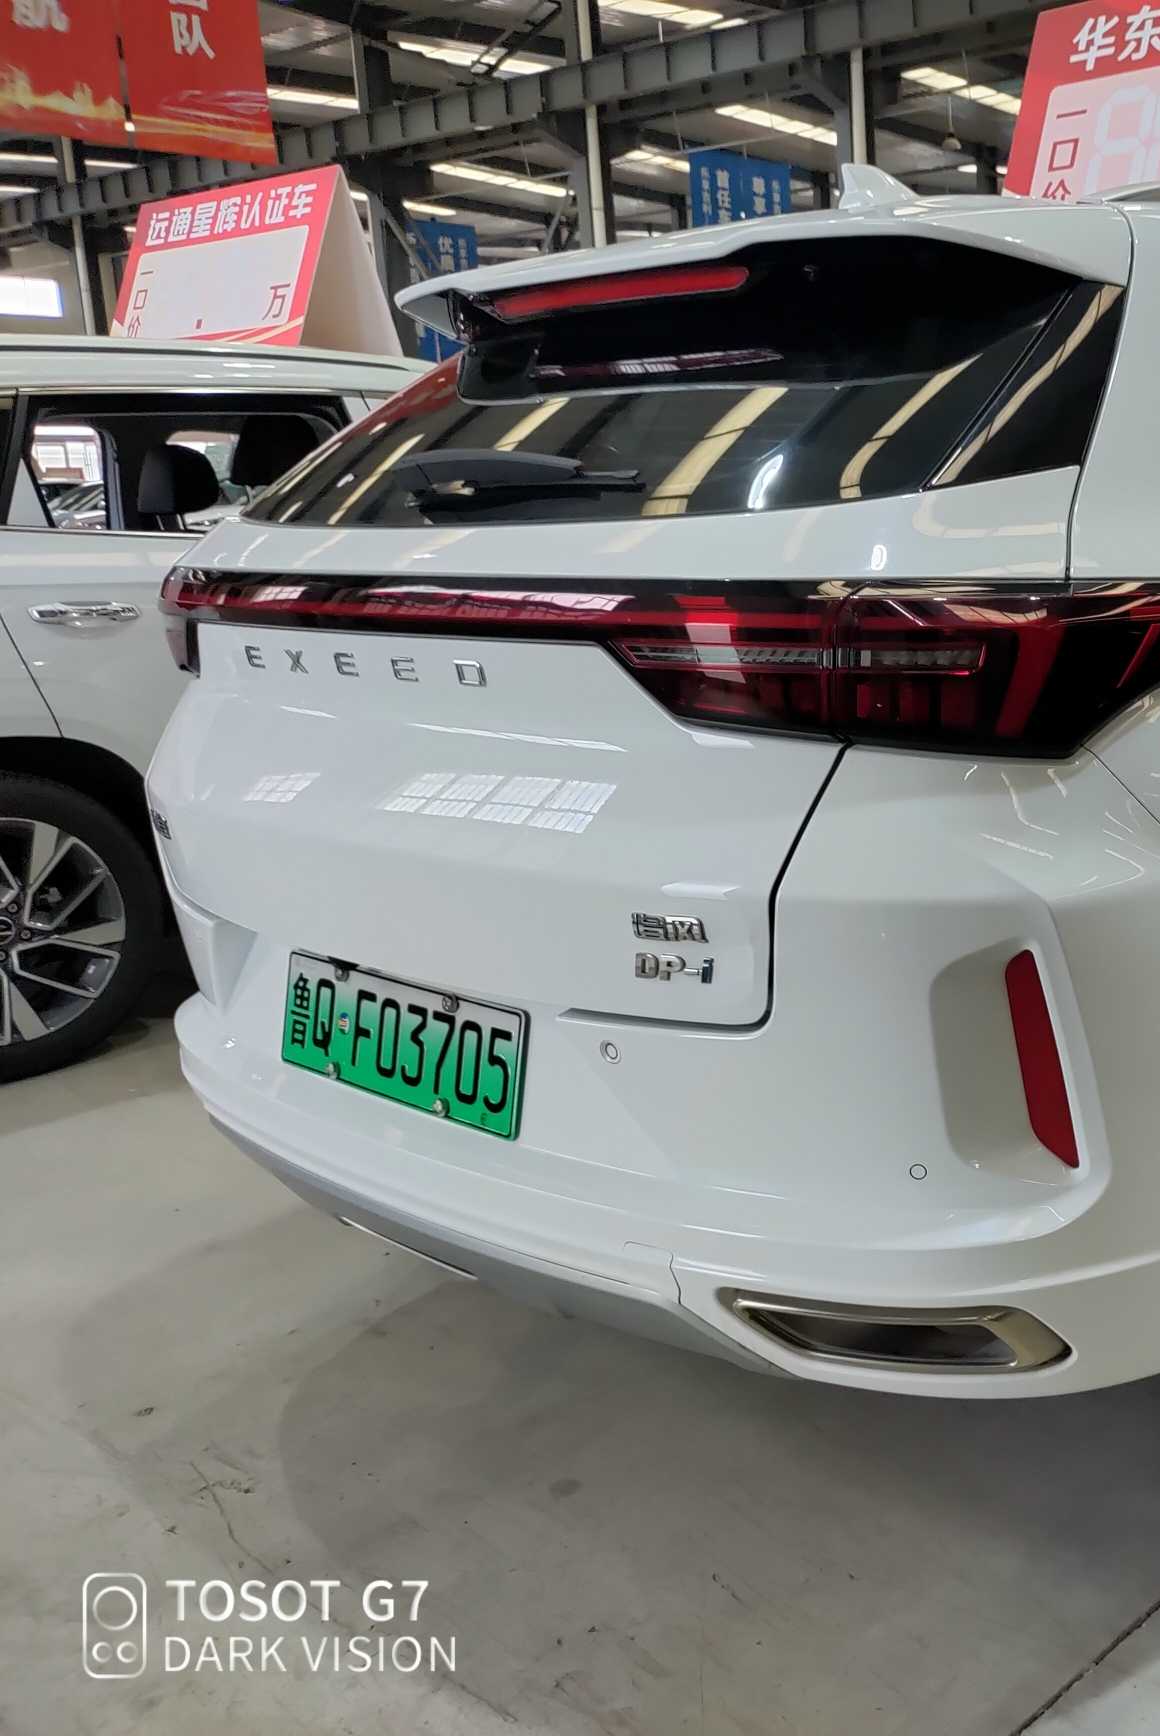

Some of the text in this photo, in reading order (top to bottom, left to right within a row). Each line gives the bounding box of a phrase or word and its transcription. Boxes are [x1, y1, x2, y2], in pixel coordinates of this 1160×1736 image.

[145, 184, 317, 247] 远通星辉认证车
[128, 269, 154, 338] 一口价
[262, 283, 291, 321] 万
[244, 645, 487, 687] EXEED
